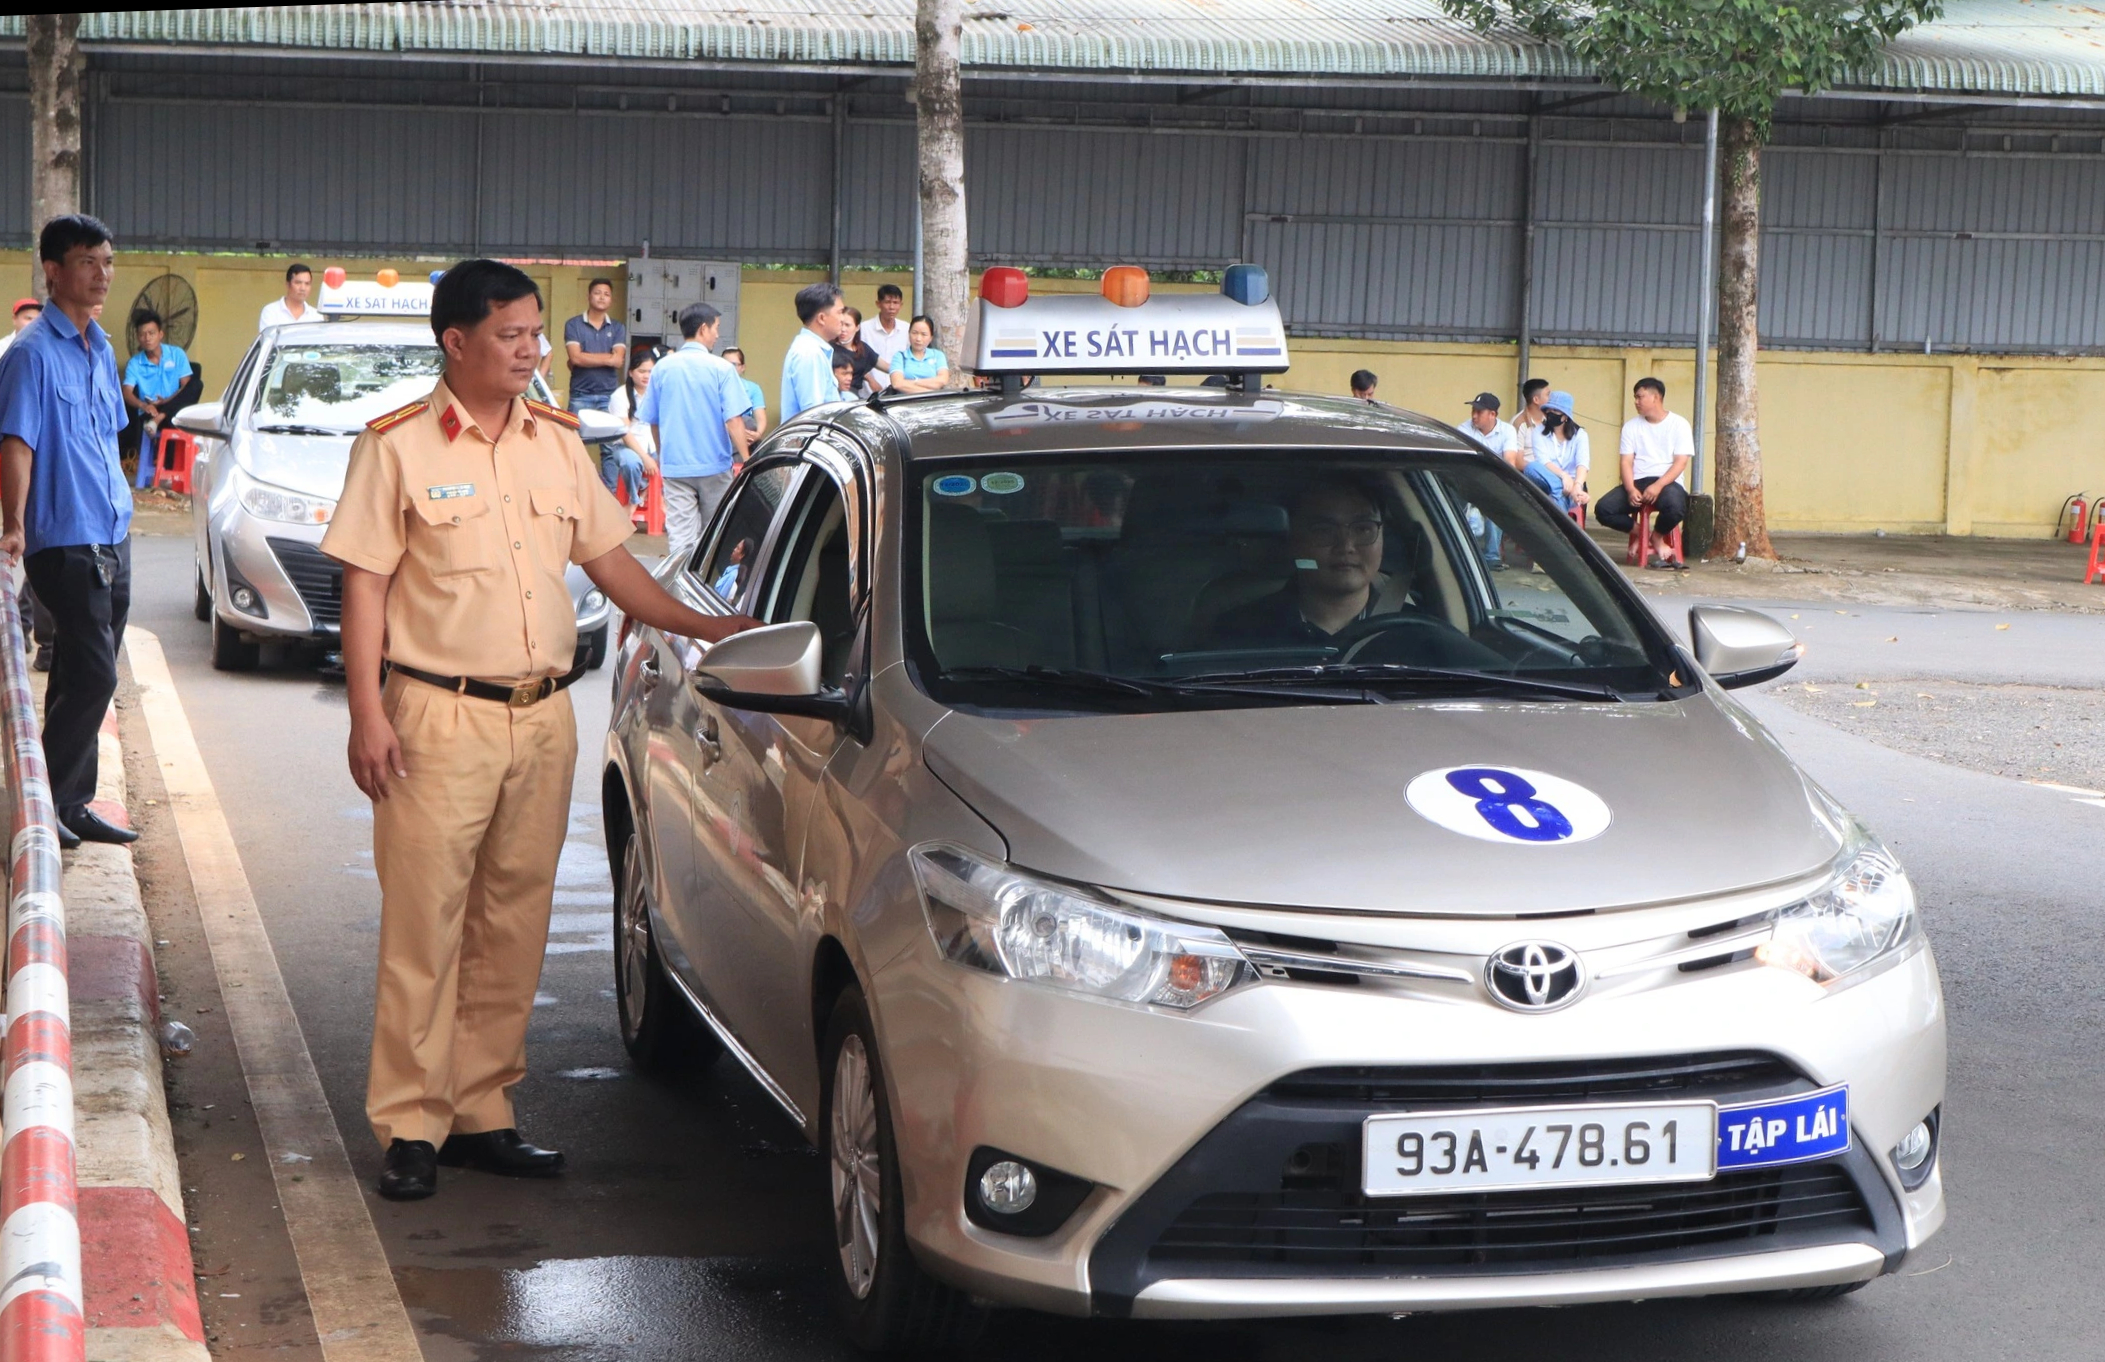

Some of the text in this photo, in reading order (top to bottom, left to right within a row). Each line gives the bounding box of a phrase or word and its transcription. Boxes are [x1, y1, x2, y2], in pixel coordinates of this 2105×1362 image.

[345, 297, 361, 309] XE
[1042, 323, 1231, 361] XE SÁT HẠCH
[1444, 767, 1574, 843] 8
[1396, 1120, 1678, 1176] 93A-478.61
[1727, 1104, 1838, 1156] TẬP LÁI
